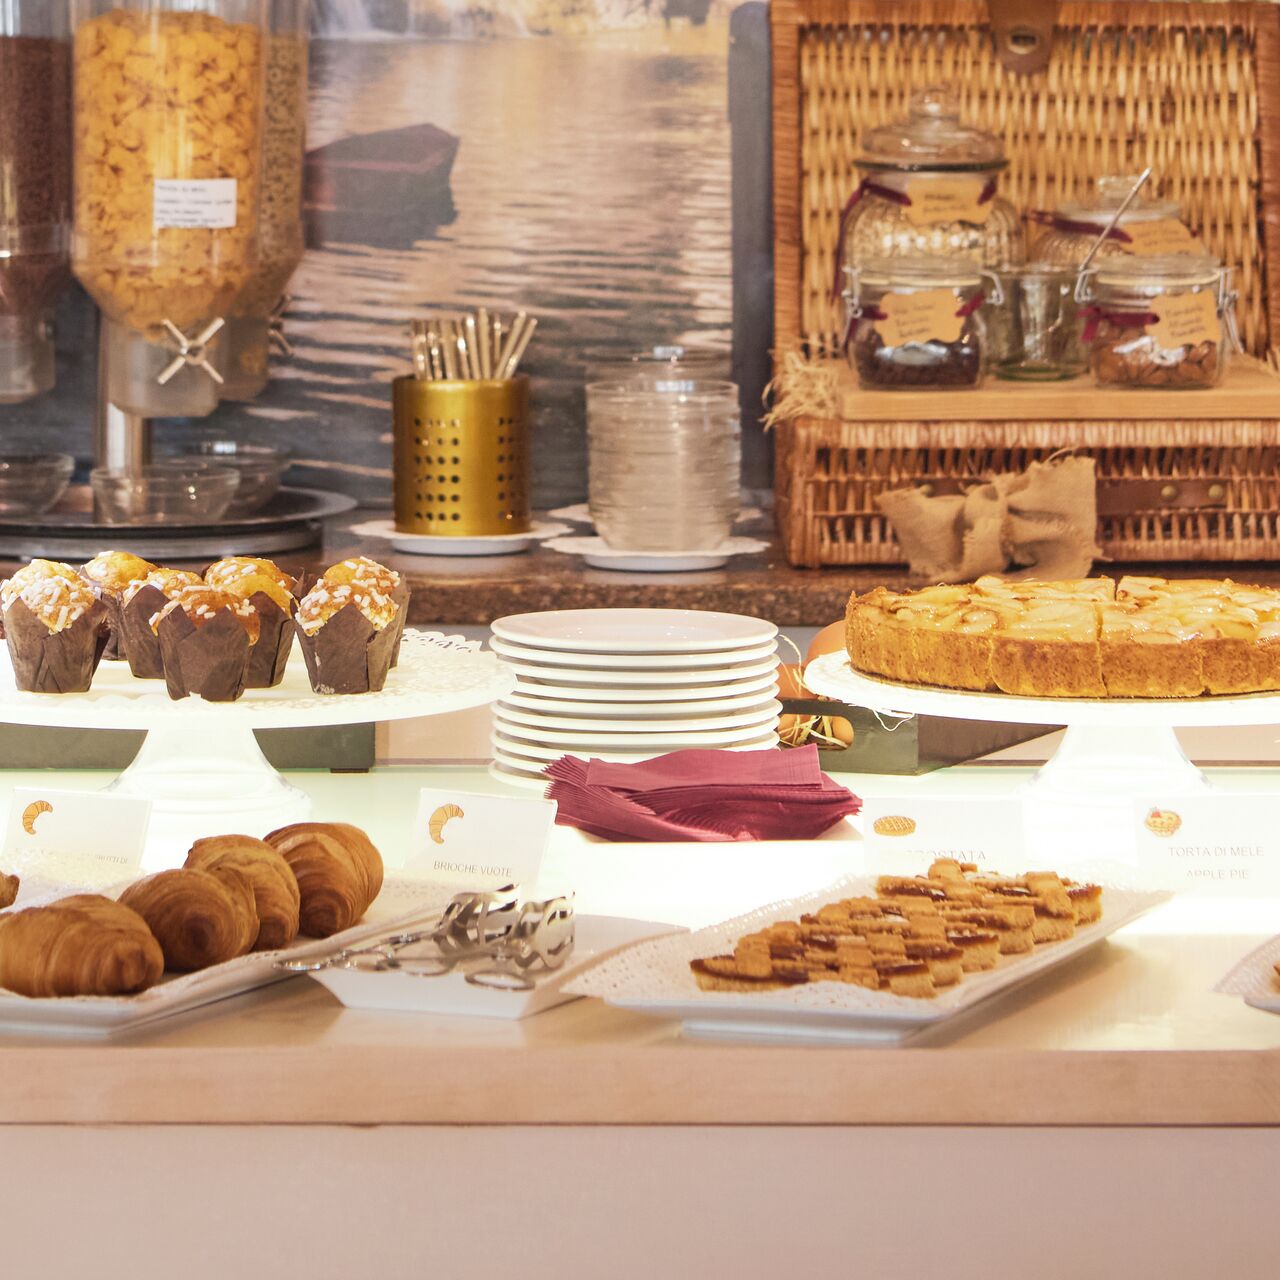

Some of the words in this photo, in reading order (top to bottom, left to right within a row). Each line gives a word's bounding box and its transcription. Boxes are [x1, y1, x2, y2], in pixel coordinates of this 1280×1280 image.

[1168, 846, 1212, 858] TORTA
[1214, 846, 1227, 858] DI
[1230, 846, 1264, 858] MELE
[433, 859, 478, 875] BRIOCHE
[480, 865, 512, 878] VUOTE
